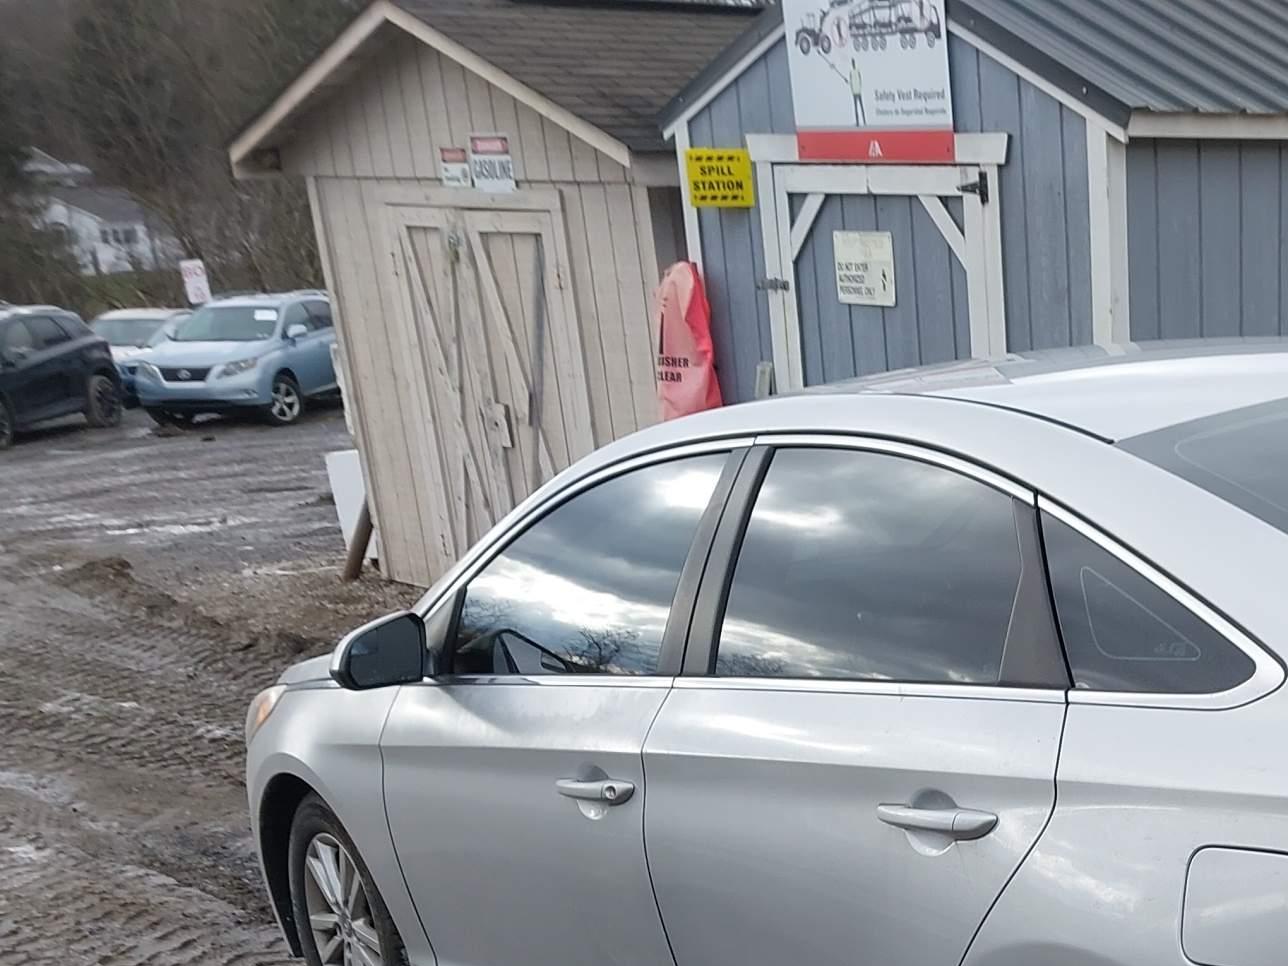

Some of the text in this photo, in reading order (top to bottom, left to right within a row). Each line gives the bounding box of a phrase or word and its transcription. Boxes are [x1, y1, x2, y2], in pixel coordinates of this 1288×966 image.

[875, 88, 946, 103] Safety Vest Required
[473, 158, 512, 180] GASOLINE
[699, 165, 735, 176] SPILL
[693, 180, 744, 191] STATION
